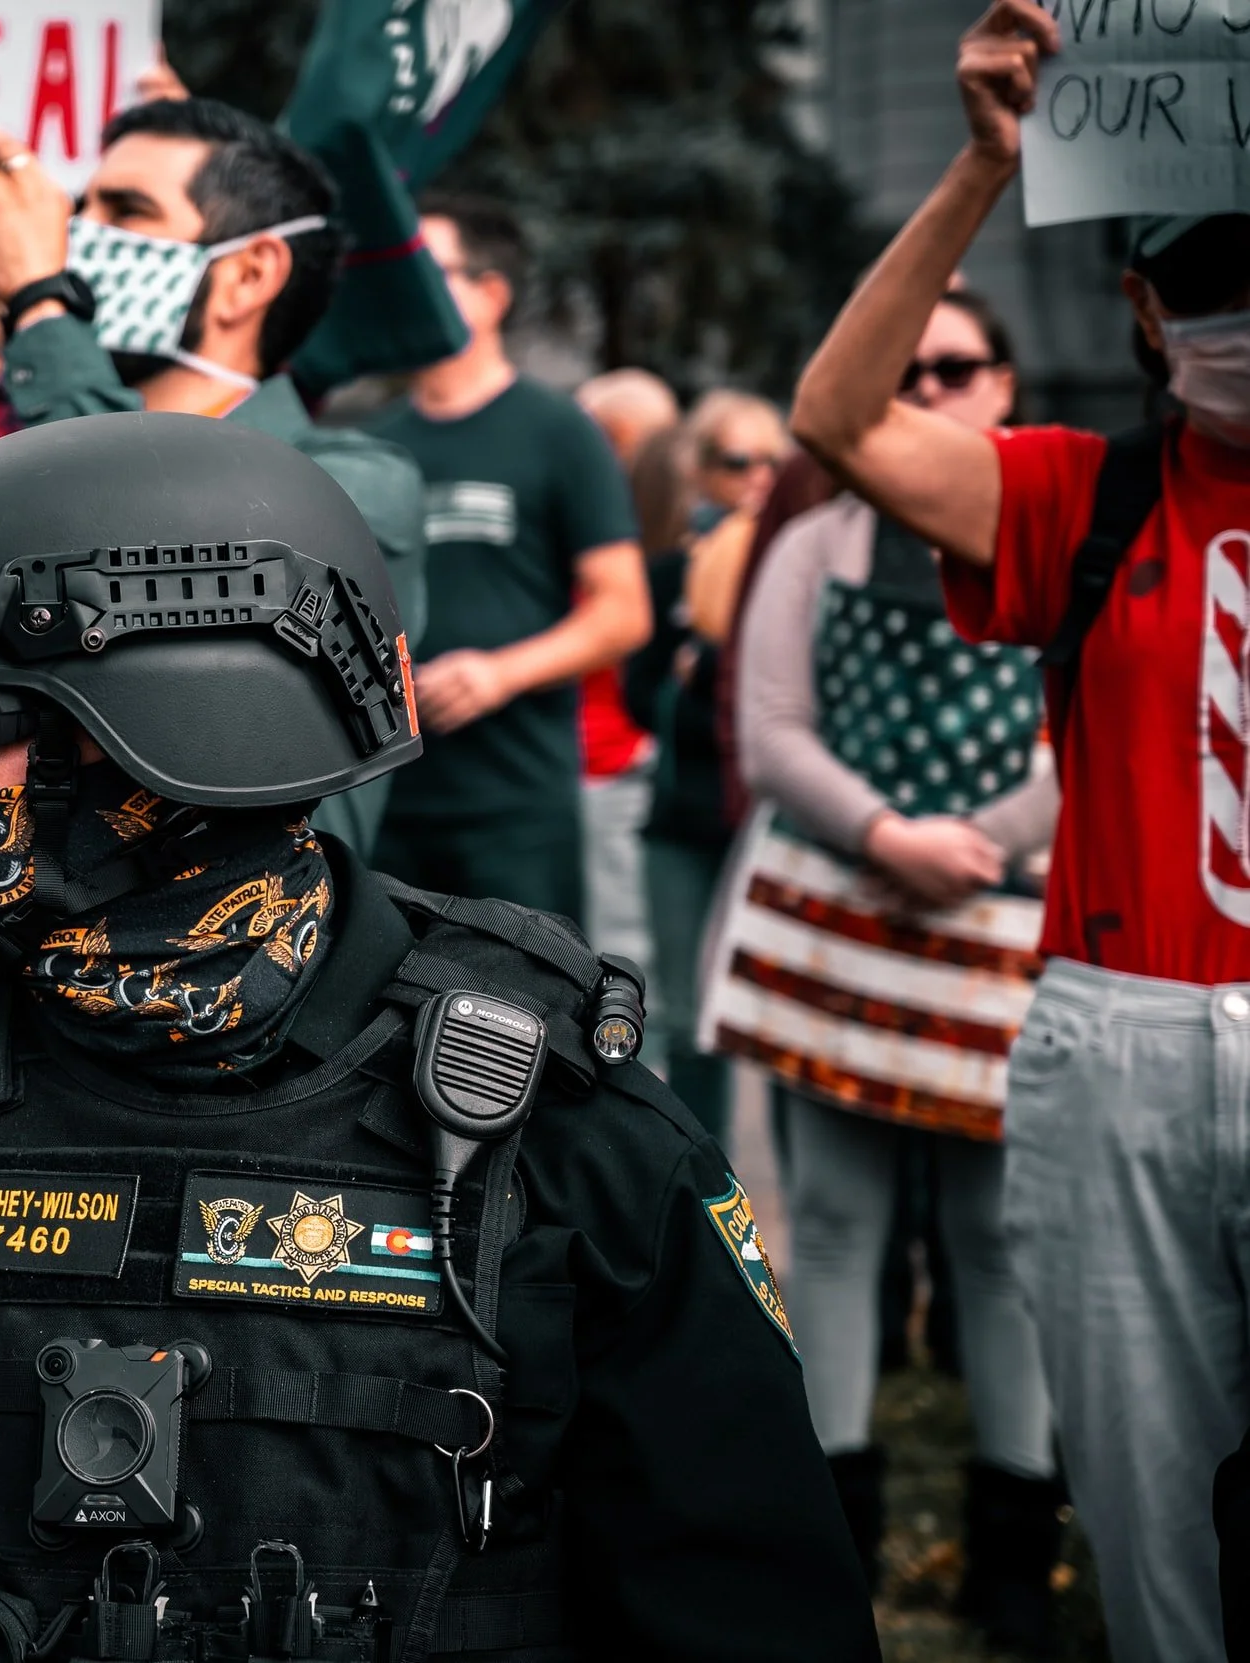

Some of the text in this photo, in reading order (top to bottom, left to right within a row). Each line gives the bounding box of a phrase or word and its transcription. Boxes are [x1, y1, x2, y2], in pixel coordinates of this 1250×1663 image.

[1049, 71, 1187, 146] OUR
[196, 882, 266, 935] STATE PATROL
[476, 1009, 531, 1032] MOTOROLA
[282, 1203, 346, 1249] COLORADO STATE PATROL
[291, 1247, 334, 1264] TROOPER
[188, 1278, 427, 1308] SPECIAL TACTICS AND RESPONSE
[89, 1510, 126, 1522] AXON
